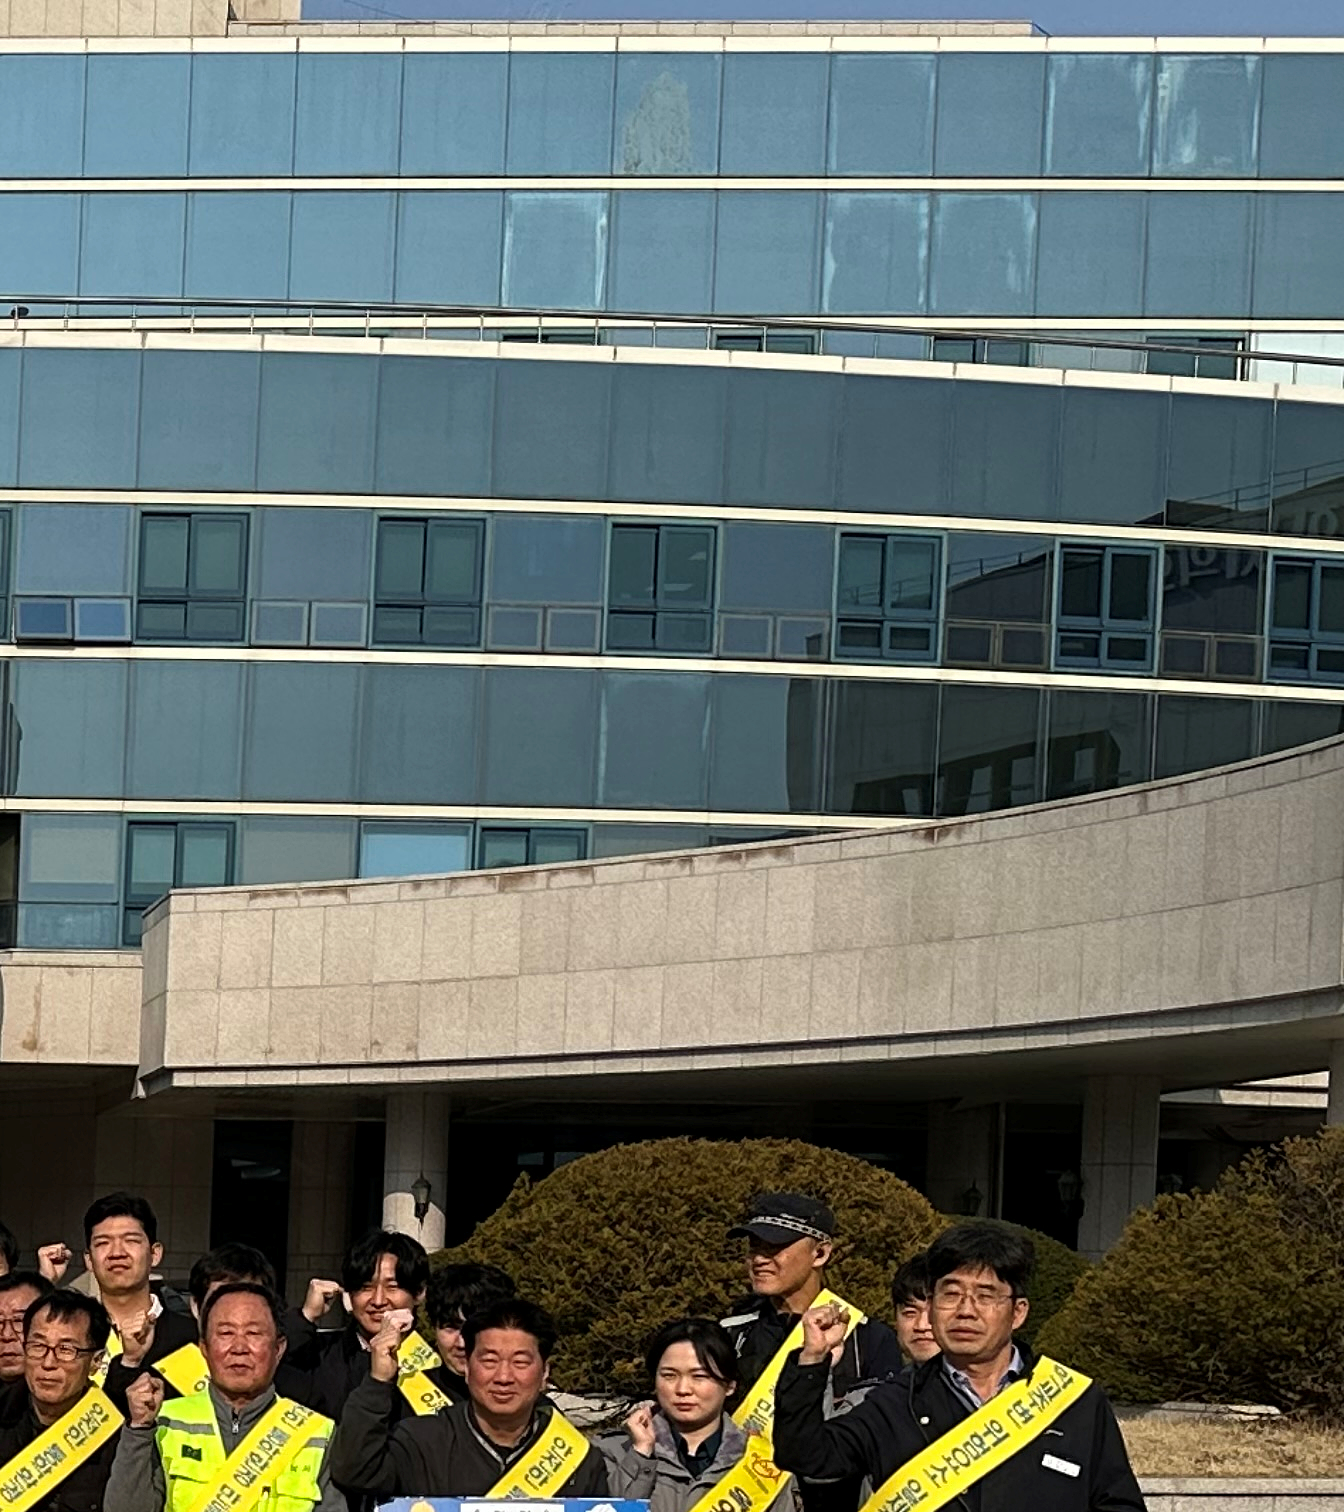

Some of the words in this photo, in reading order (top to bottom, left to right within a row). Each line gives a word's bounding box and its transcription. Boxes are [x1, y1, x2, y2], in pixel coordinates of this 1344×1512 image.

[58, 1401, 111, 1450] 안전한
[1002, 1361, 1076, 1430] 학교주변
[516, 1434, 580, 1492] 안전한
[922, 1412, 1009, 1493] 위험요소
